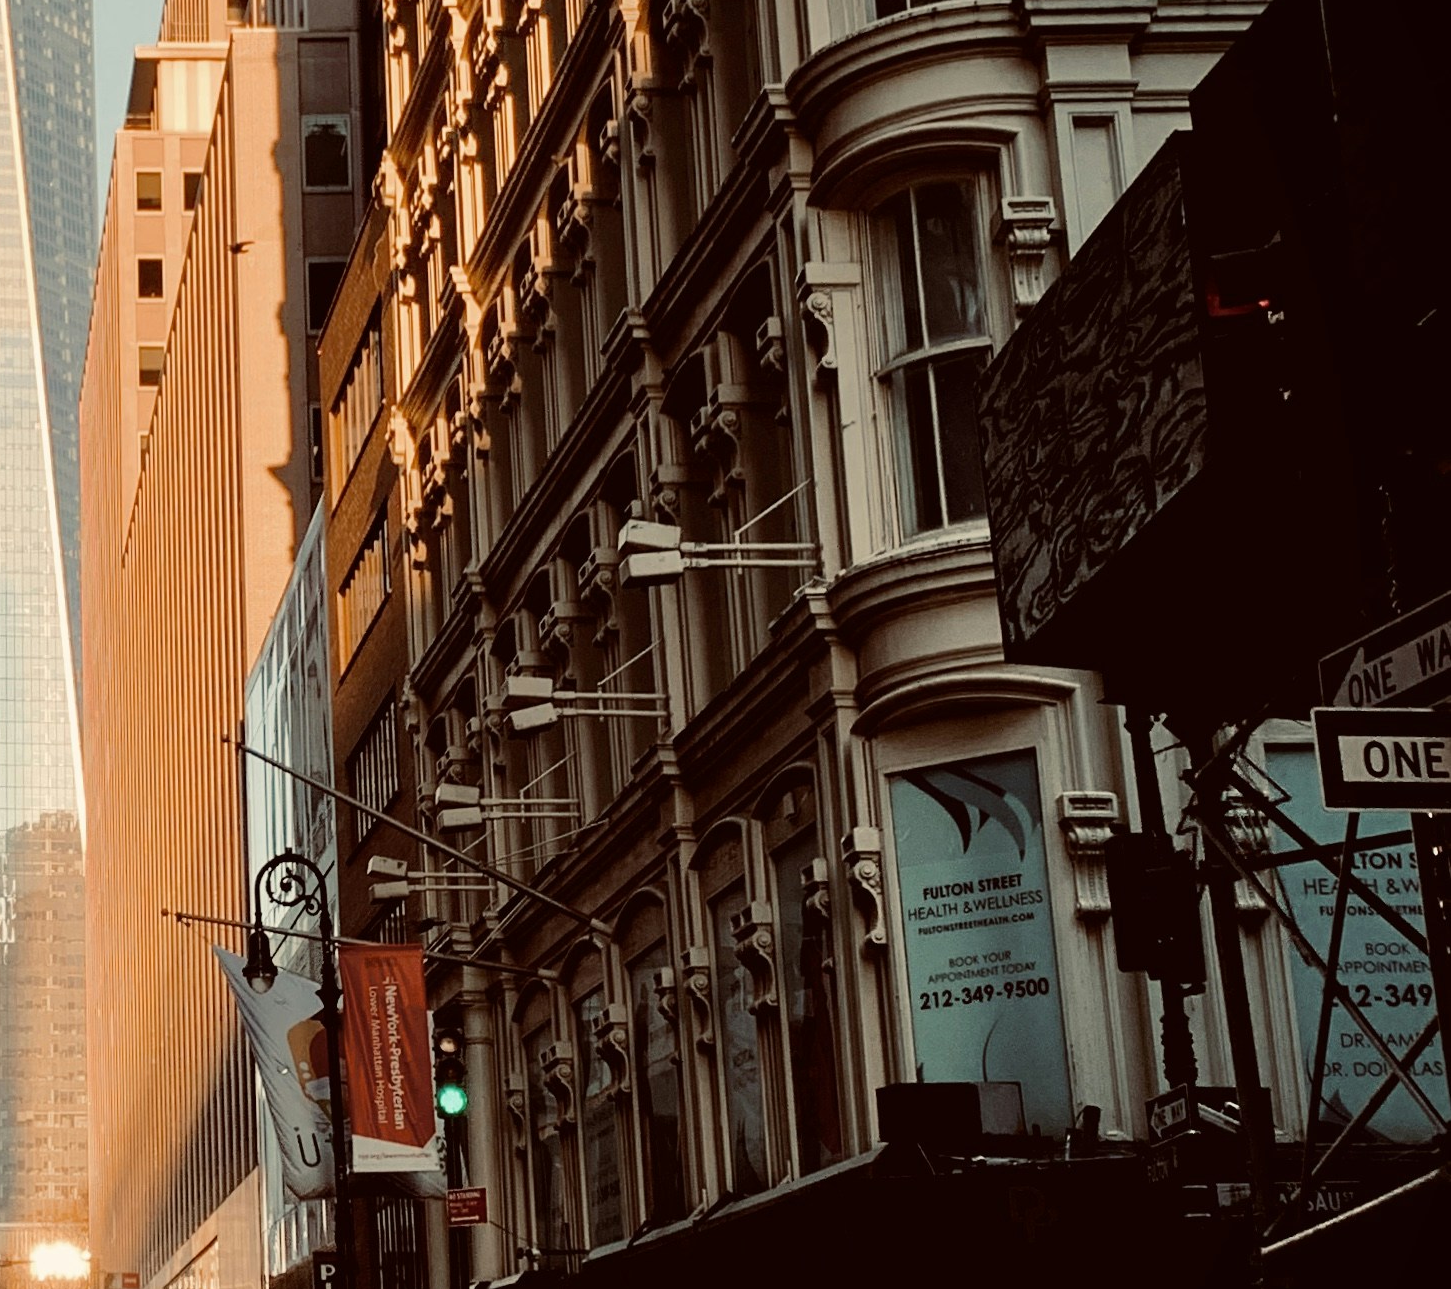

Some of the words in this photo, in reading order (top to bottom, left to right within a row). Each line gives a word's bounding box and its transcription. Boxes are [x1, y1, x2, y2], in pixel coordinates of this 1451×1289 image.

[1349, 657, 1397, 707] ONE
[1416, 629, 1451, 677] WA
[1364, 740, 1450, 778] ONE
[923, 881, 974, 901] FULTON
[978, 874, 1022, 893] STREET
[908, 903, 958, 921] HEALTH
[949, 956, 978, 968] BOOK
[983, 951, 1011, 964] YOUR
[1365, 942, 1411, 956] BOOK
[927, 967, 999, 984] APPOINTMENT
[1001, 961, 1037, 975] TODAY
[368, 986, 380, 1017] Lower
[920, 977, 1049, 1010] 212-349-9500
[371, 1019, 384, 1078] Manhattan
[374, 1080, 389, 1124] Hospital
